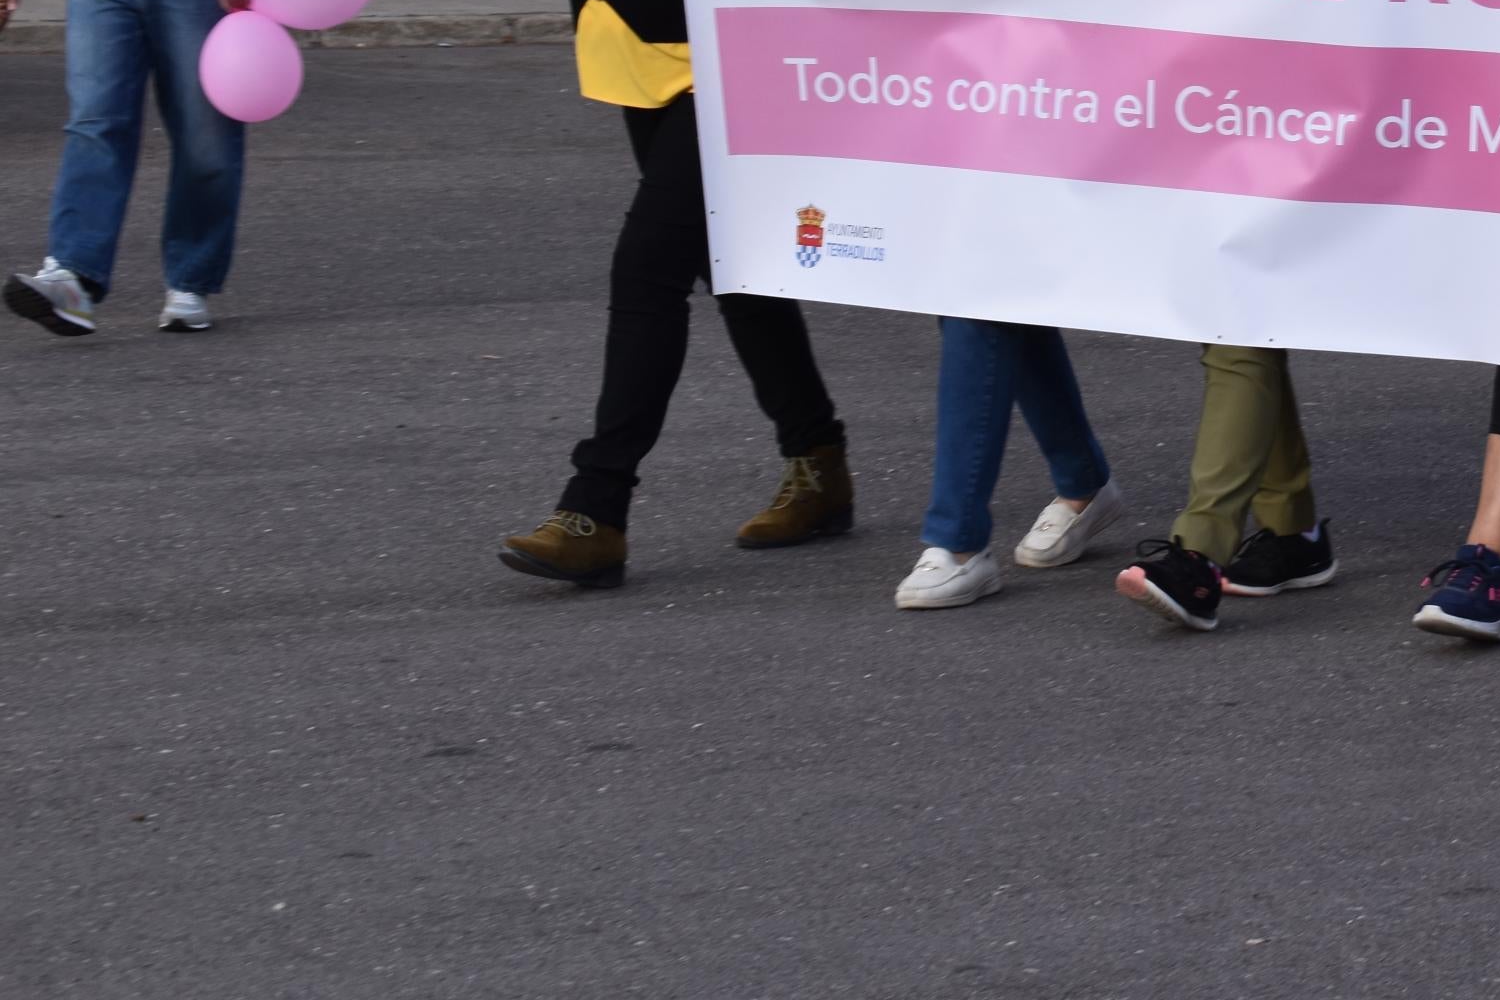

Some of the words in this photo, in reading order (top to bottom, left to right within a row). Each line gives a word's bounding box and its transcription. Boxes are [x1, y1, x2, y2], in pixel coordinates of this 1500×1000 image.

[782, 56, 934, 109] Todos
[946, 78, 1099, 124] contra
[1113, 79, 1156, 129] el
[1174, 84, 1359, 147] Cáncer
[1376, 98, 1448, 150] de
[827, 222, 885, 241] AYUNTAMIENTO
[826, 241, 886, 262] TERRADILLOS
